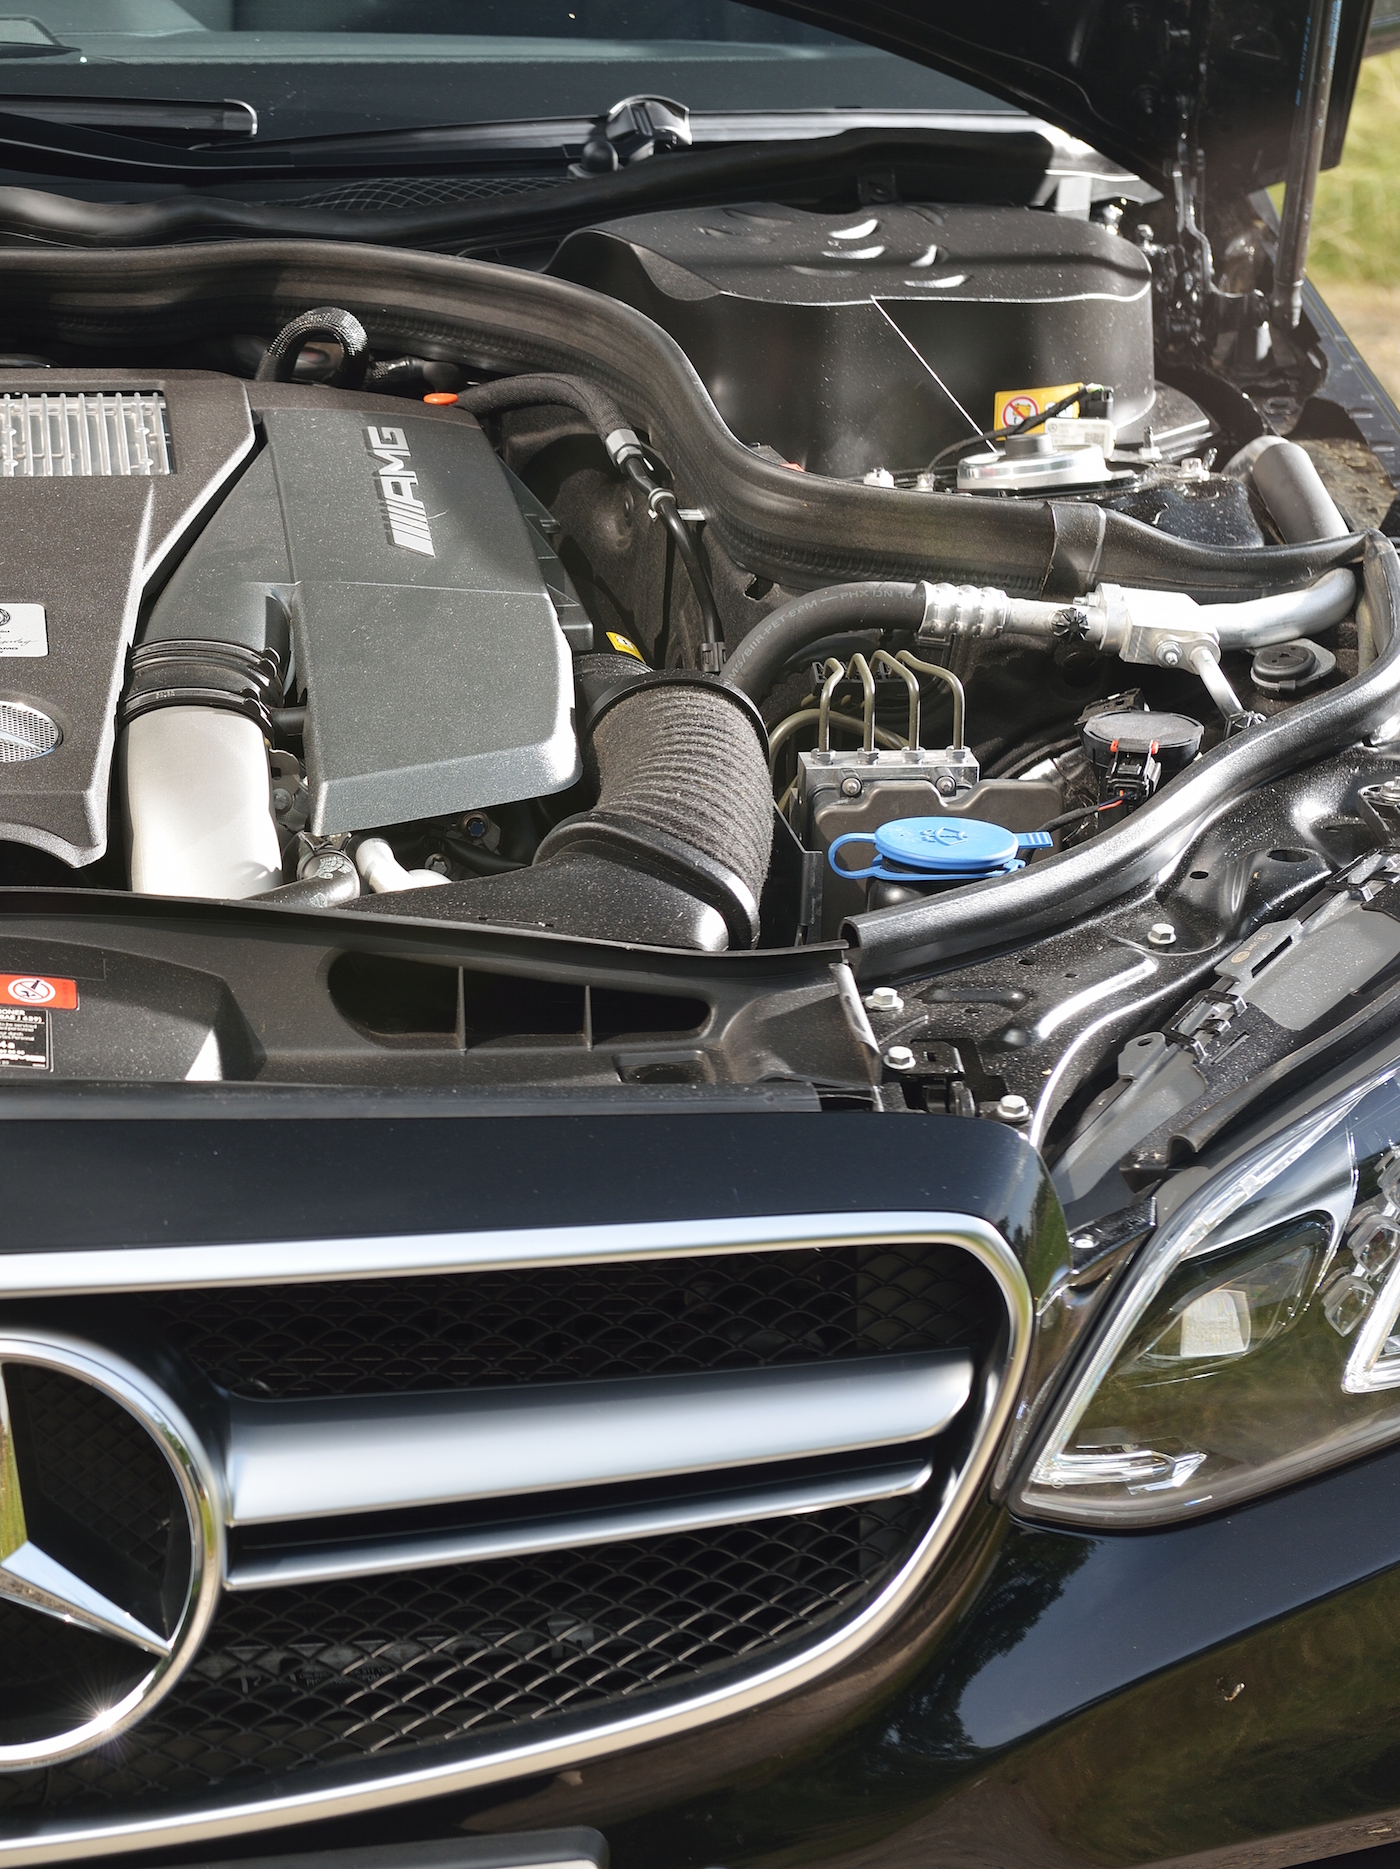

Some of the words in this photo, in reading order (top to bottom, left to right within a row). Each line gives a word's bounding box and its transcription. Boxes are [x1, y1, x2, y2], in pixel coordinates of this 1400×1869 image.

[367, 426, 426, 511] AMG
[840, 590, 869, 600] PHX
[898, 591, 913, 600] 16
